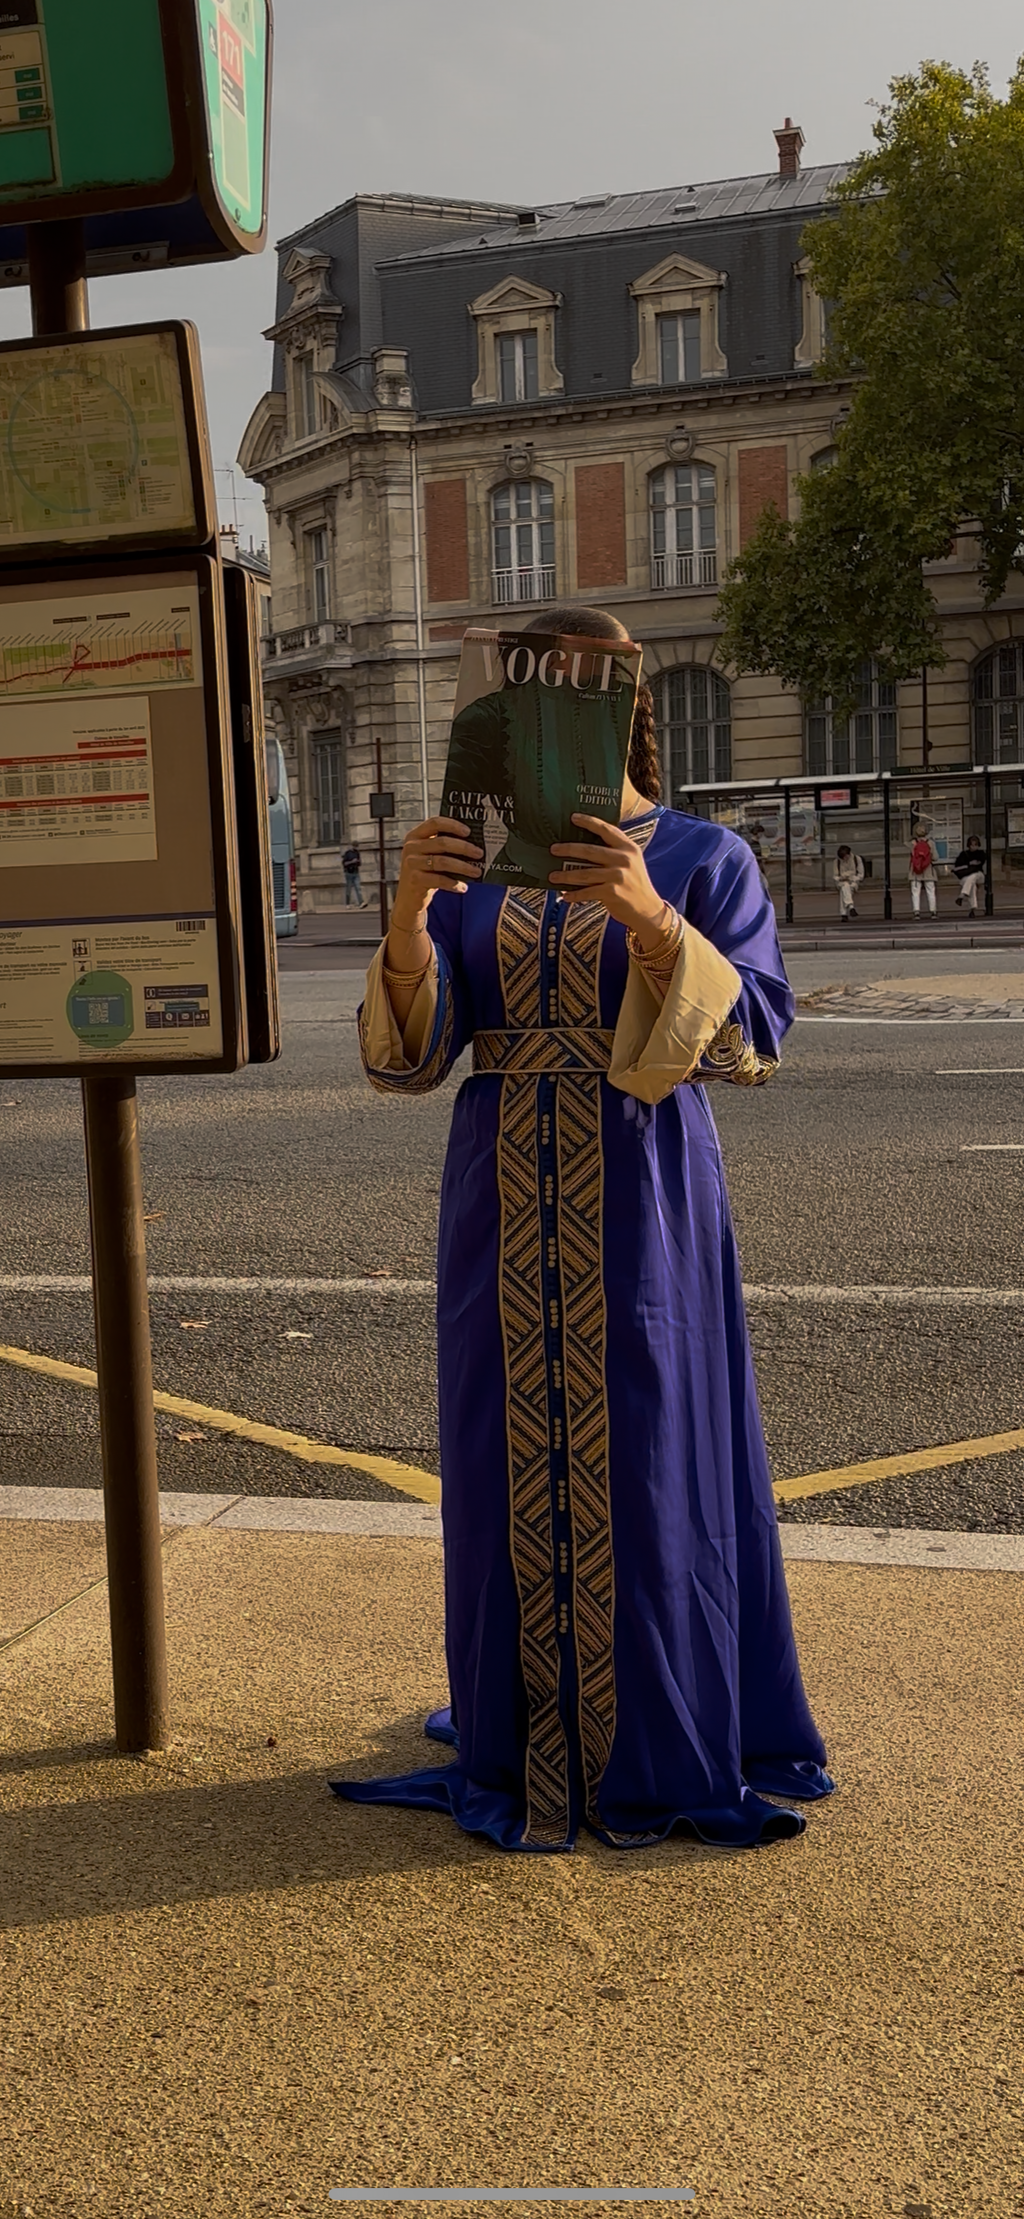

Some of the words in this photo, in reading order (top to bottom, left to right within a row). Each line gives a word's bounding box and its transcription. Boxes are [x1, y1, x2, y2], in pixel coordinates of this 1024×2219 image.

[222, 30, 241, 76] 171
[480, 644, 625, 694] VOGUE
[449, 790, 502, 808] CAFTAN
[504, 795, 514, 809] &
[576, 784, 620, 797] OCTOBER
[579, 794, 618, 807] EDITION
[448, 805, 516, 824] TAKCHITA
